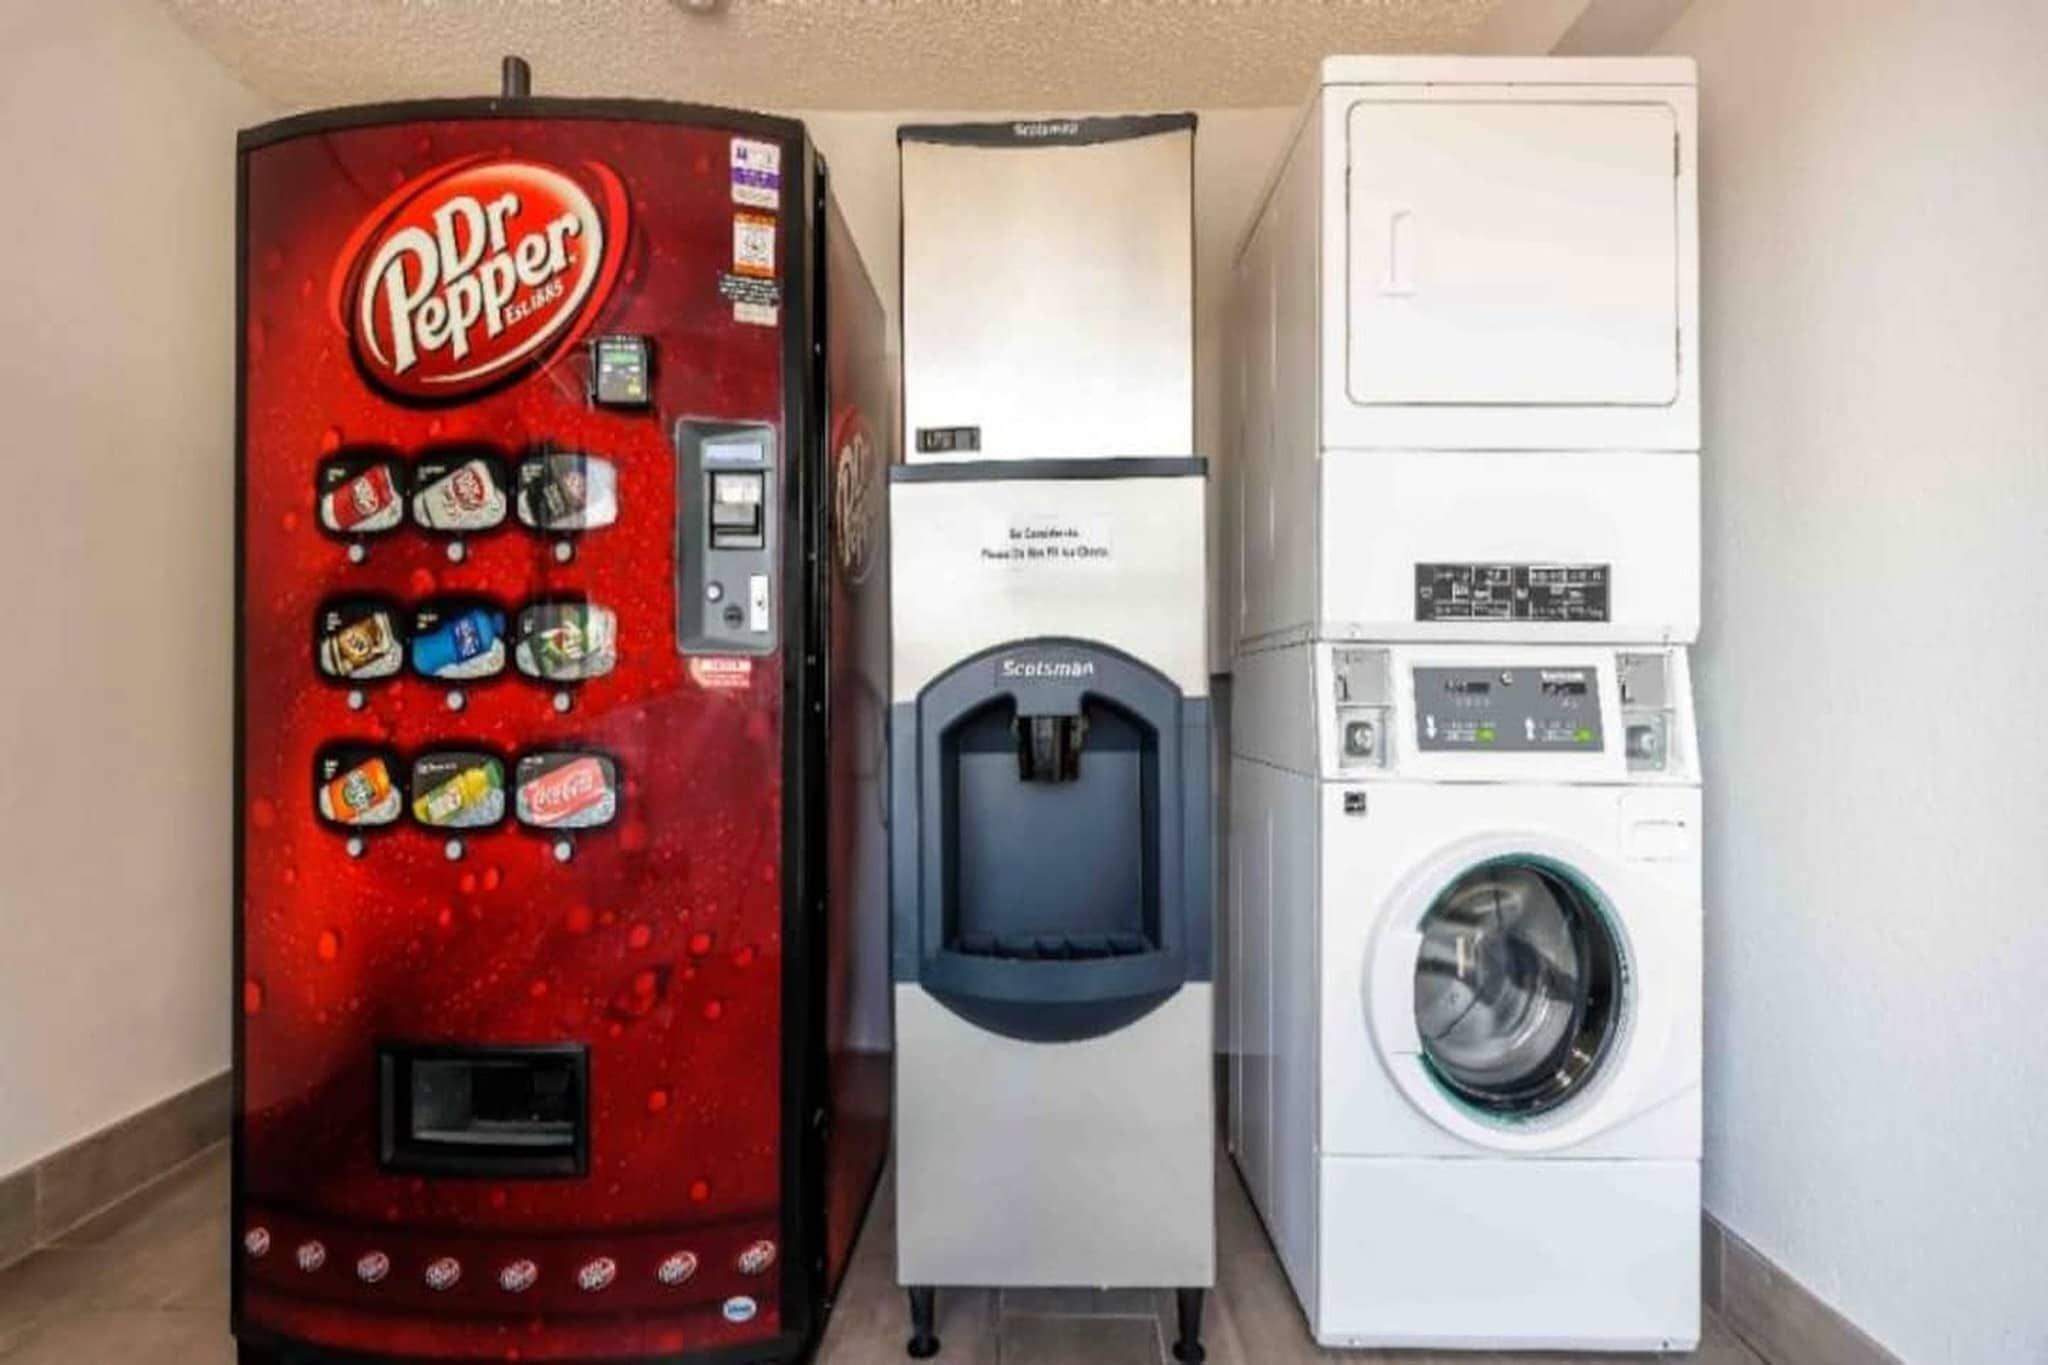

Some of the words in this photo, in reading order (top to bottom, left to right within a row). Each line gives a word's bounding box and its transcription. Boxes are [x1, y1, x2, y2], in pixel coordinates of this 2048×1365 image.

[433, 192, 520, 285] Dr
[362, 211, 582, 375] Pepper
[1002, 660, 1094, 677] Scotsman
